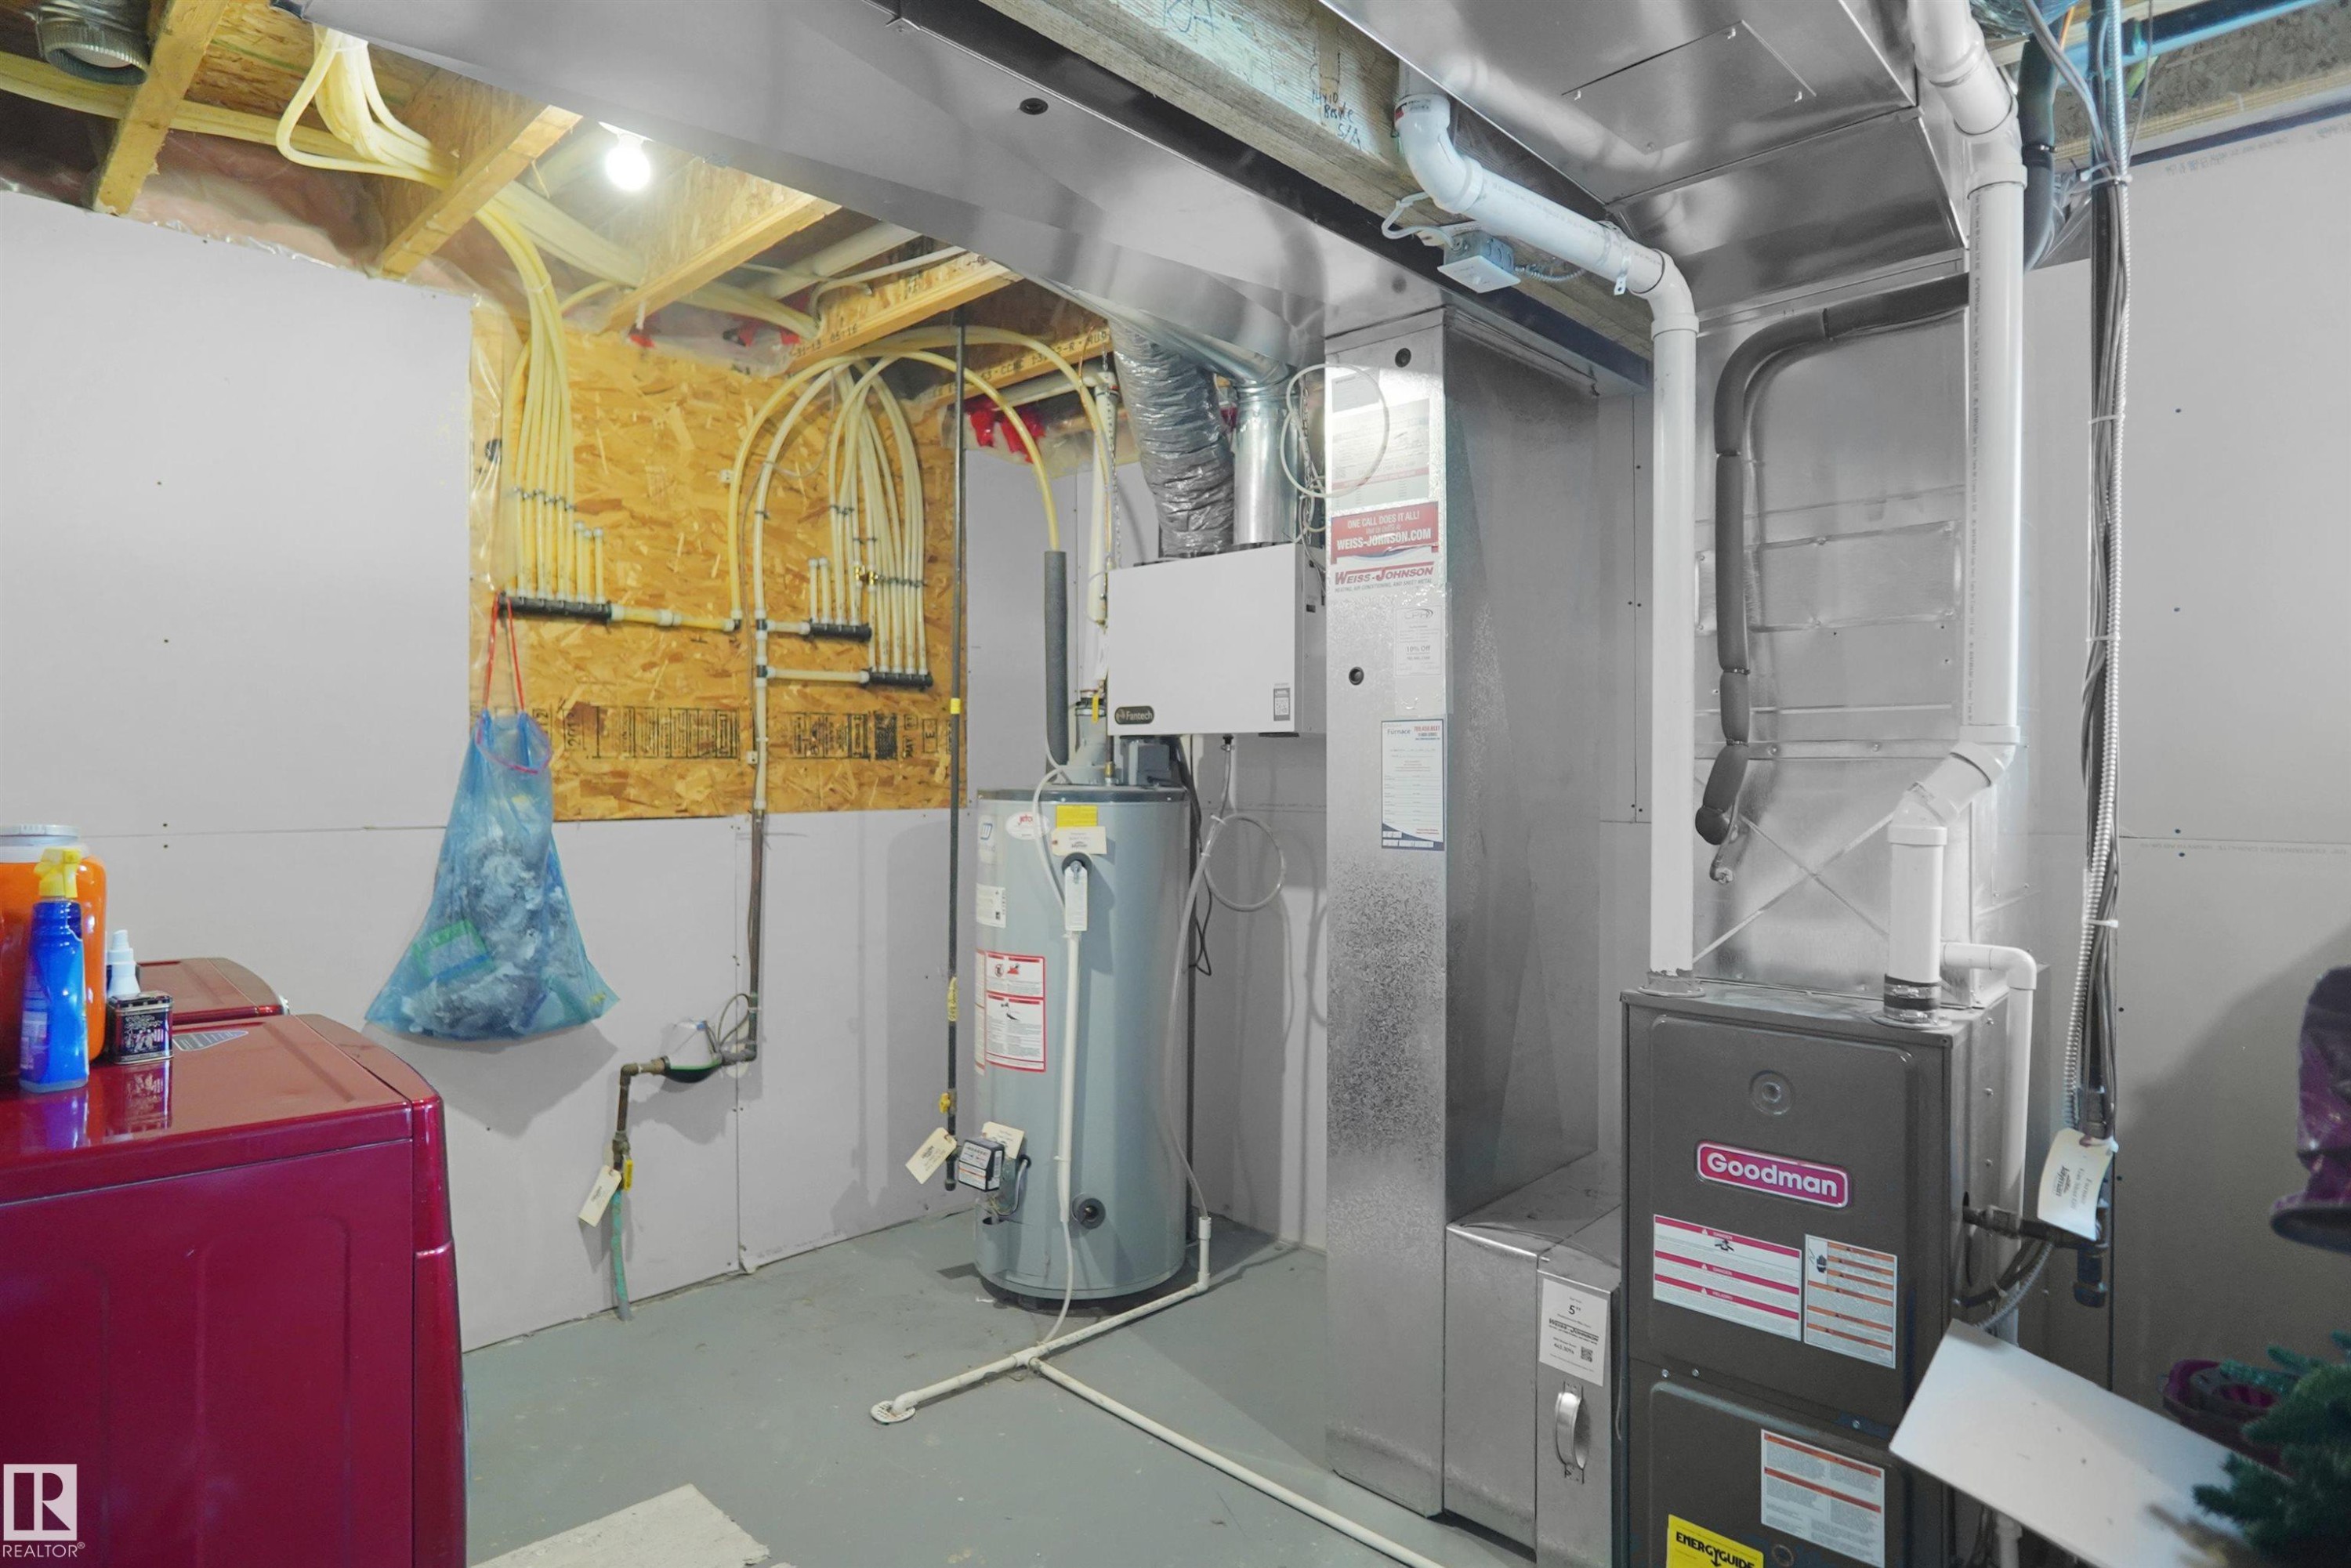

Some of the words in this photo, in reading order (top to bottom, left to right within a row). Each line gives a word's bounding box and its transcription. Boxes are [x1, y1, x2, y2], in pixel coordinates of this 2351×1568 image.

[1362, 517, 1377, 527] CALL
[1379, 514, 1397, 523] DOES
[1337, 528, 1432, 551] WEISS-JOHNSON.COM
[1125, 708, 1154, 721] Fantech
[1707, 1152, 1837, 1197] Goodman
